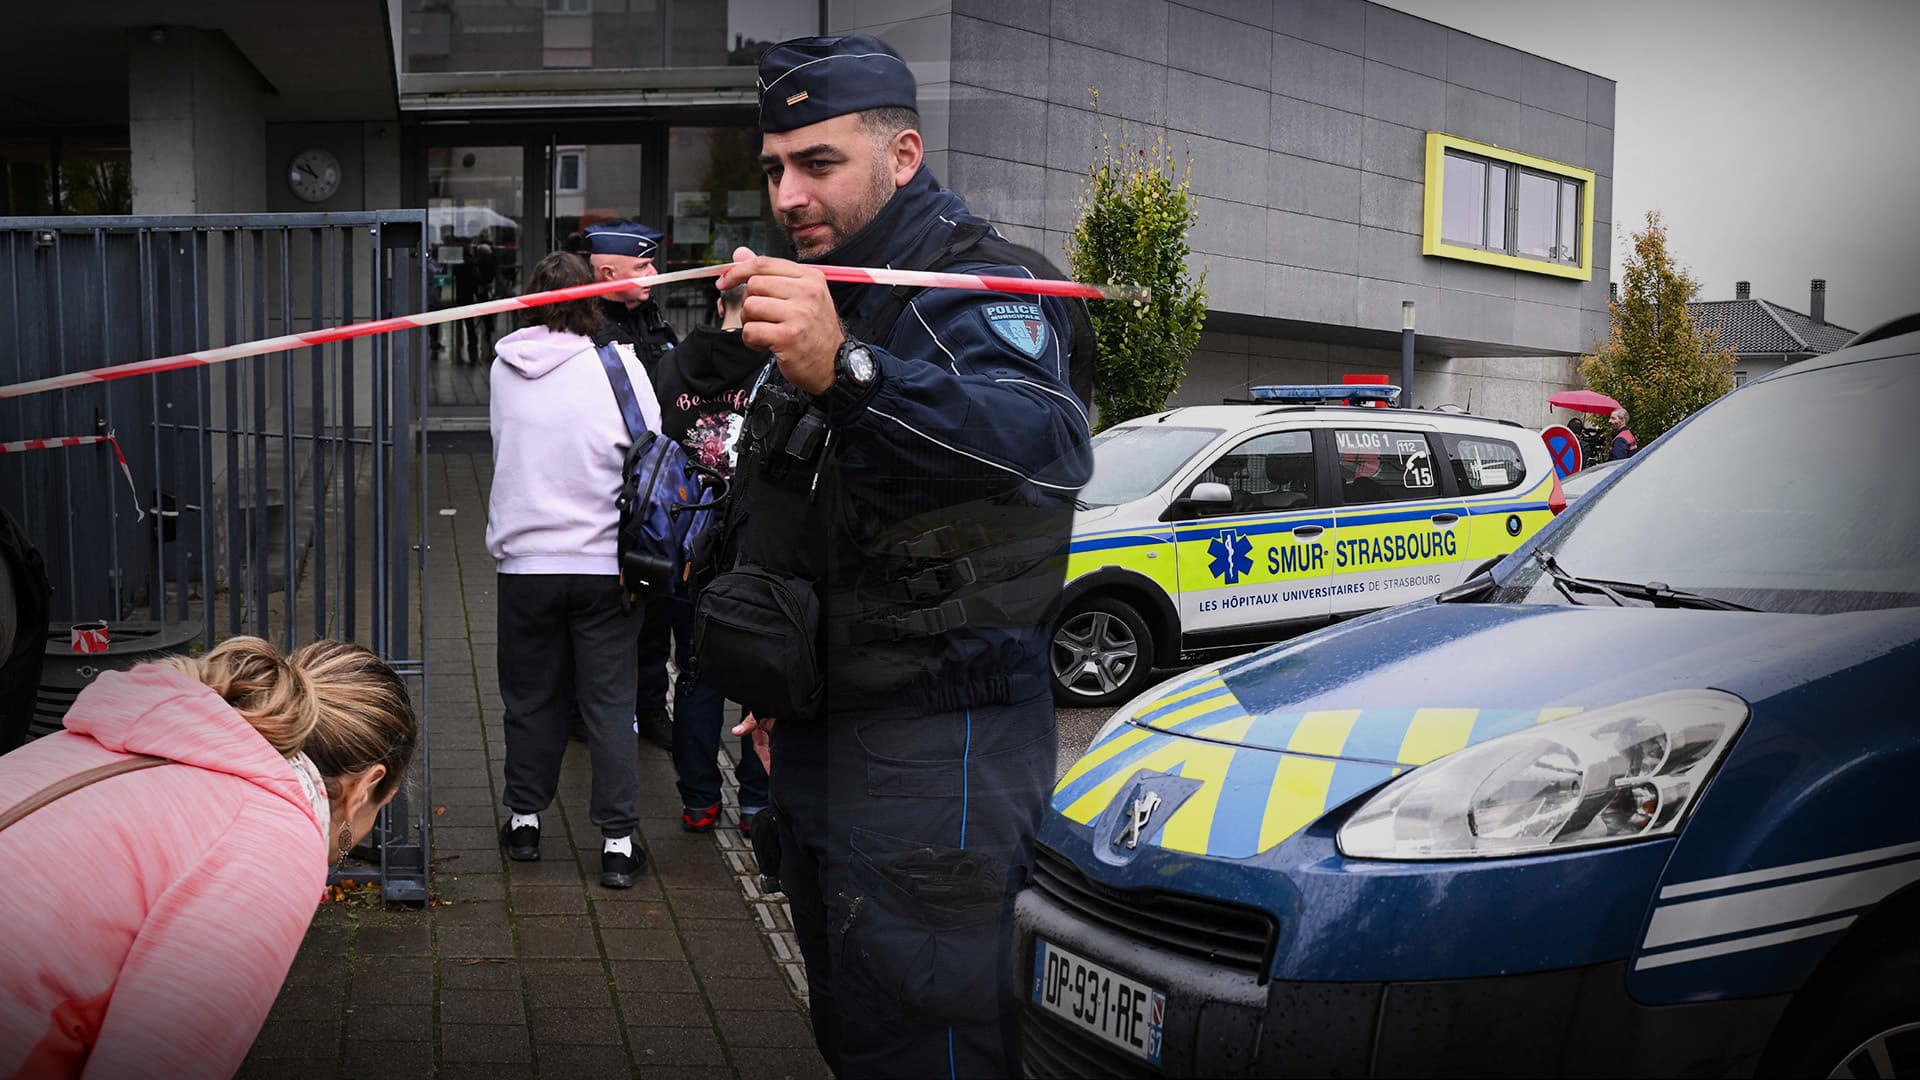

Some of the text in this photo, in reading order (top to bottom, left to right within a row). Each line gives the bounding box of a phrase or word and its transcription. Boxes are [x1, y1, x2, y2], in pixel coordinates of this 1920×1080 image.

[986, 305, 1040, 316] POLICE
[991, 313, 1040, 321] MUNICIPALE
[1336, 433, 1390, 449] VL LOG 1
[1398, 442, 1417, 452] 112
[1411, 467, 1432, 486] 15
[1267, 530, 1457, 575] SMUR STRASBOURG
[1199, 574, 1441, 612] LES HÔPITAUX UNIVERSITAIRES DE STRASBOURG
[1045, 951, 1147, 1049] DP-931-RE
[1148, 1029, 1162, 1058] 67
